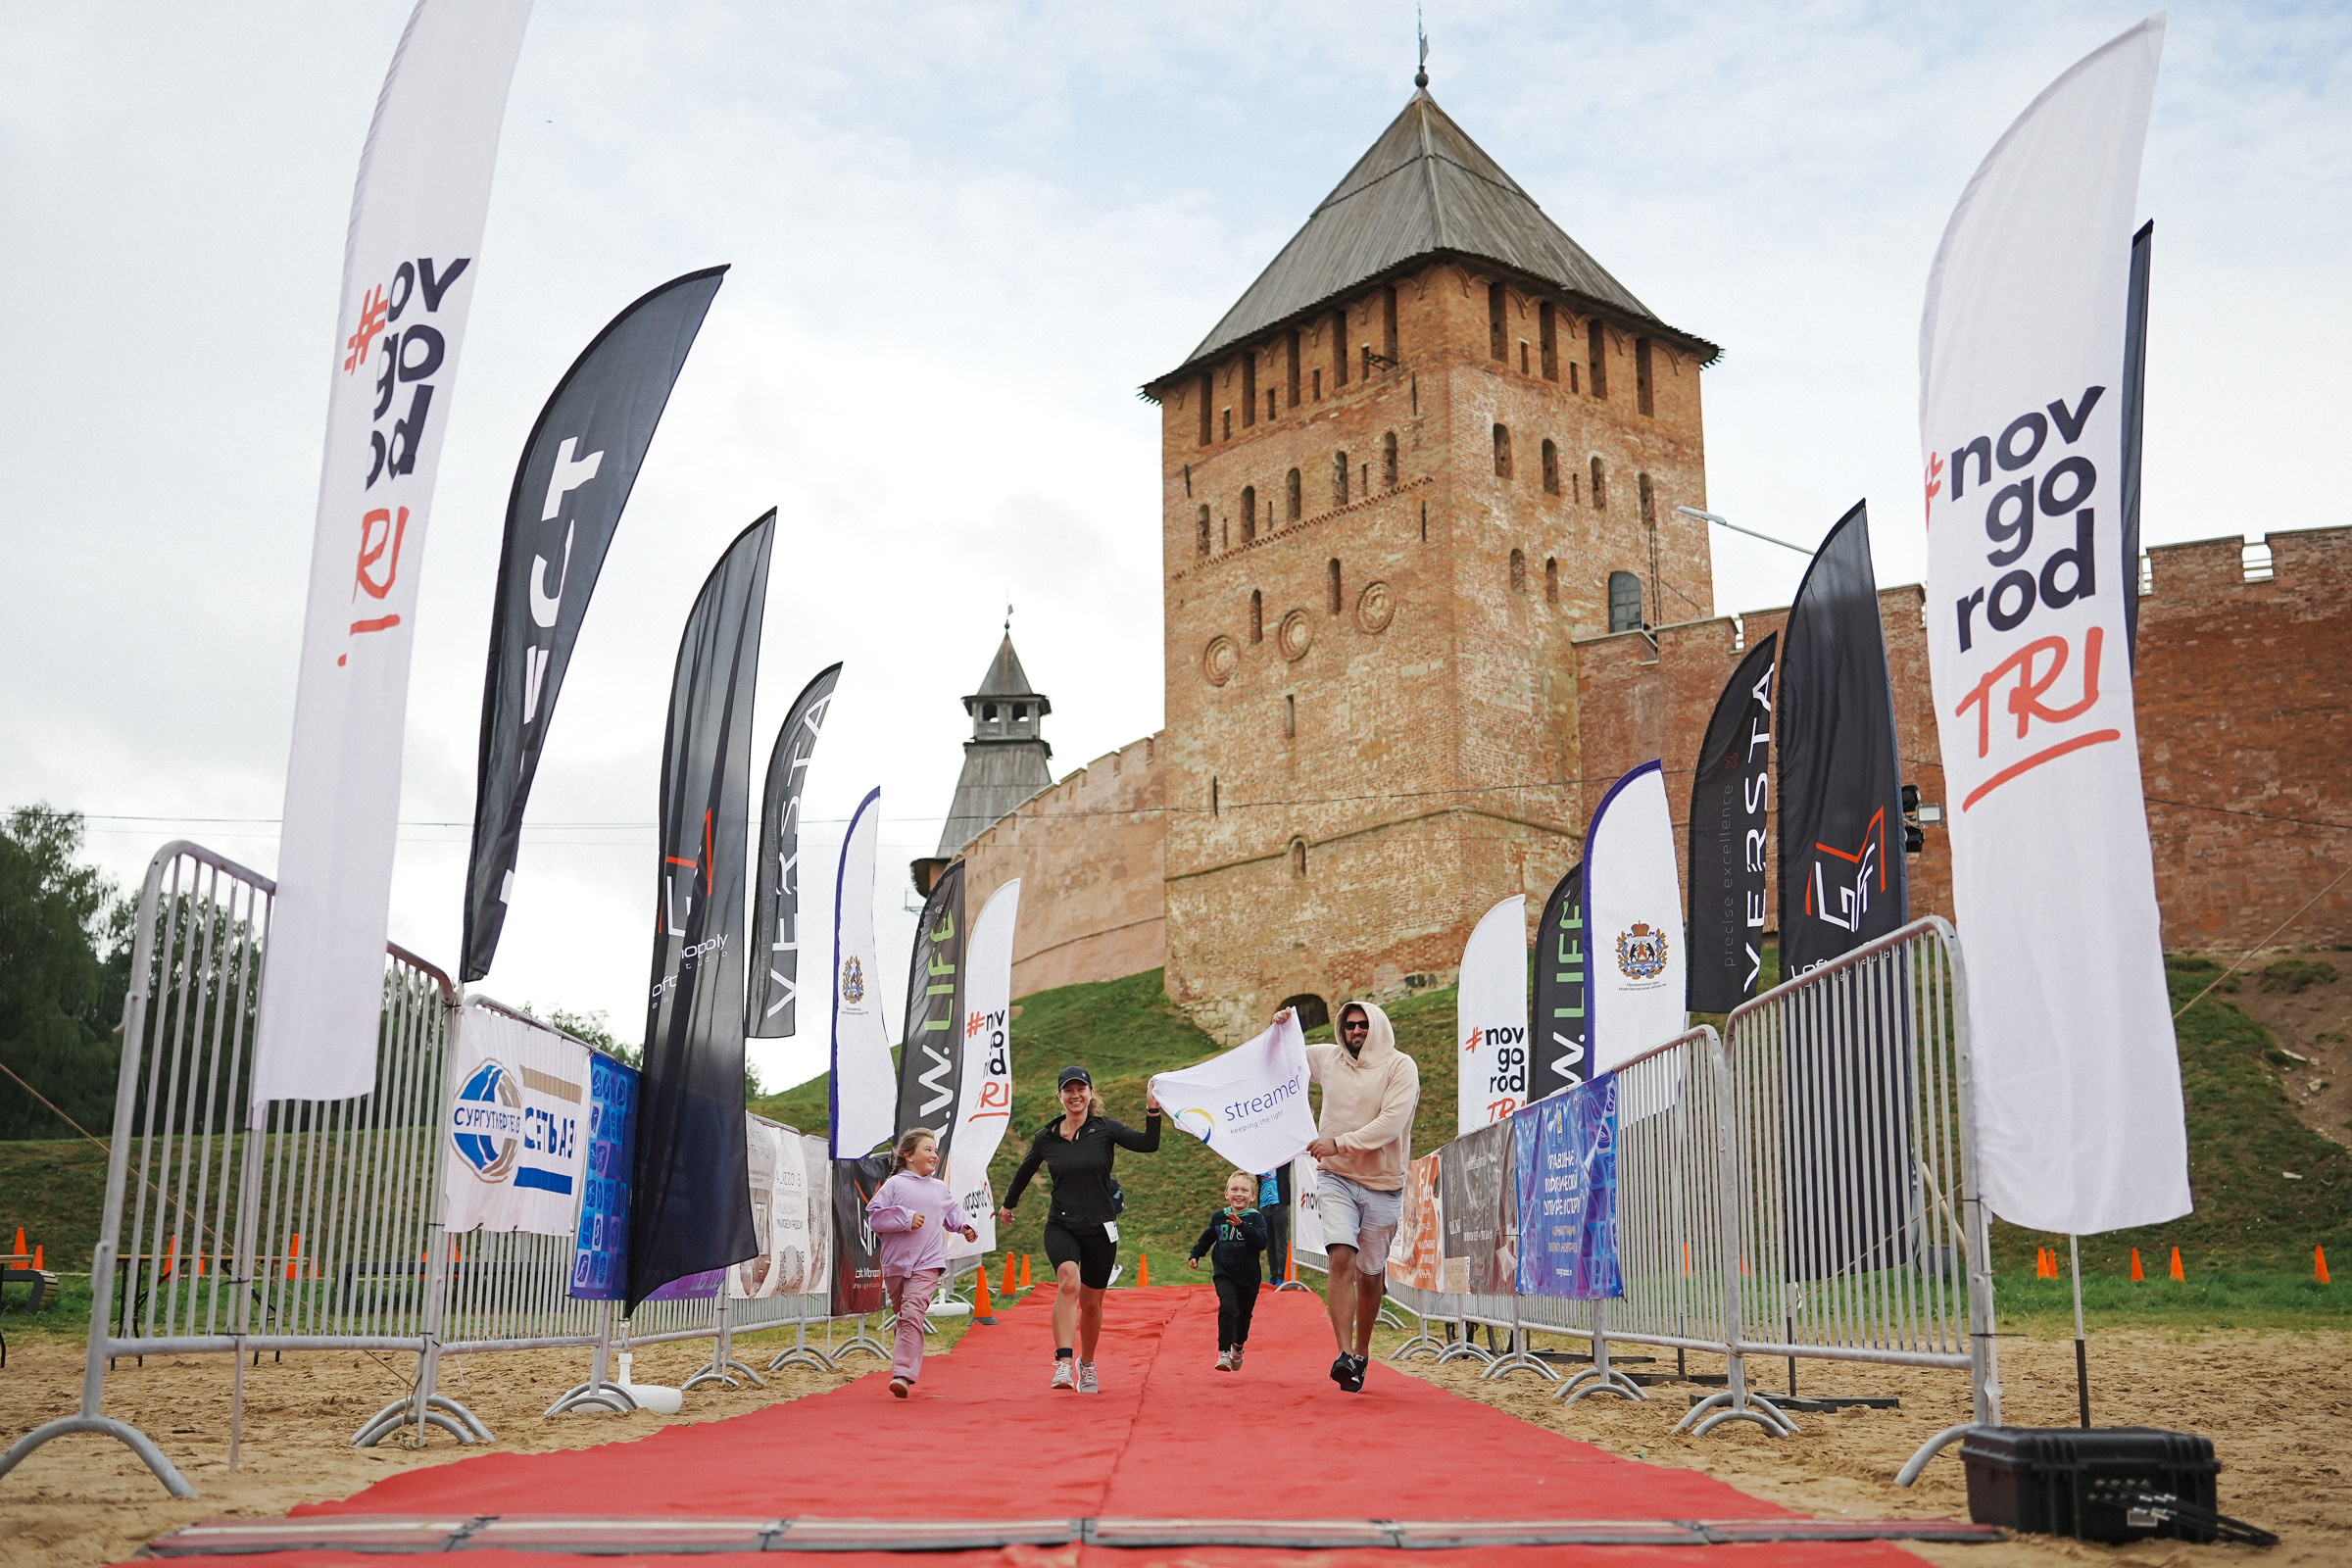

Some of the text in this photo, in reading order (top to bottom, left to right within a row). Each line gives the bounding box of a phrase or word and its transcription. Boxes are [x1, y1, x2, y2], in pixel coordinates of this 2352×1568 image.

[343, 258, 471, 377] #ov
[366, 383, 436, 491] od
[352, 506, 411, 606] RI
[1984, 456, 2097, 568] go
[1956, 508, 2096, 654] rod
[1955, 626, 2105, 759] TRI
[1719, 784, 1735, 968] precise excellence
[1743, 662, 1776, 993] VERSTA
[652, 974, 678, 998] oft
[923, 908, 956, 1031] LIFE
[1553, 901, 1586, 1018] LIFE
[1465, 1025, 1525, 1054] #nov
[1490, 1065, 1526, 1094] rod
[1497, 1048, 1525, 1073] go
[523, 1106, 578, 1159] СЕТЬ АЗ
[1224, 1074, 1300, 1122] streamer
[1230, 1109, 1284, 1135] keeping the light
[1487, 1098, 1526, 1124] TR
